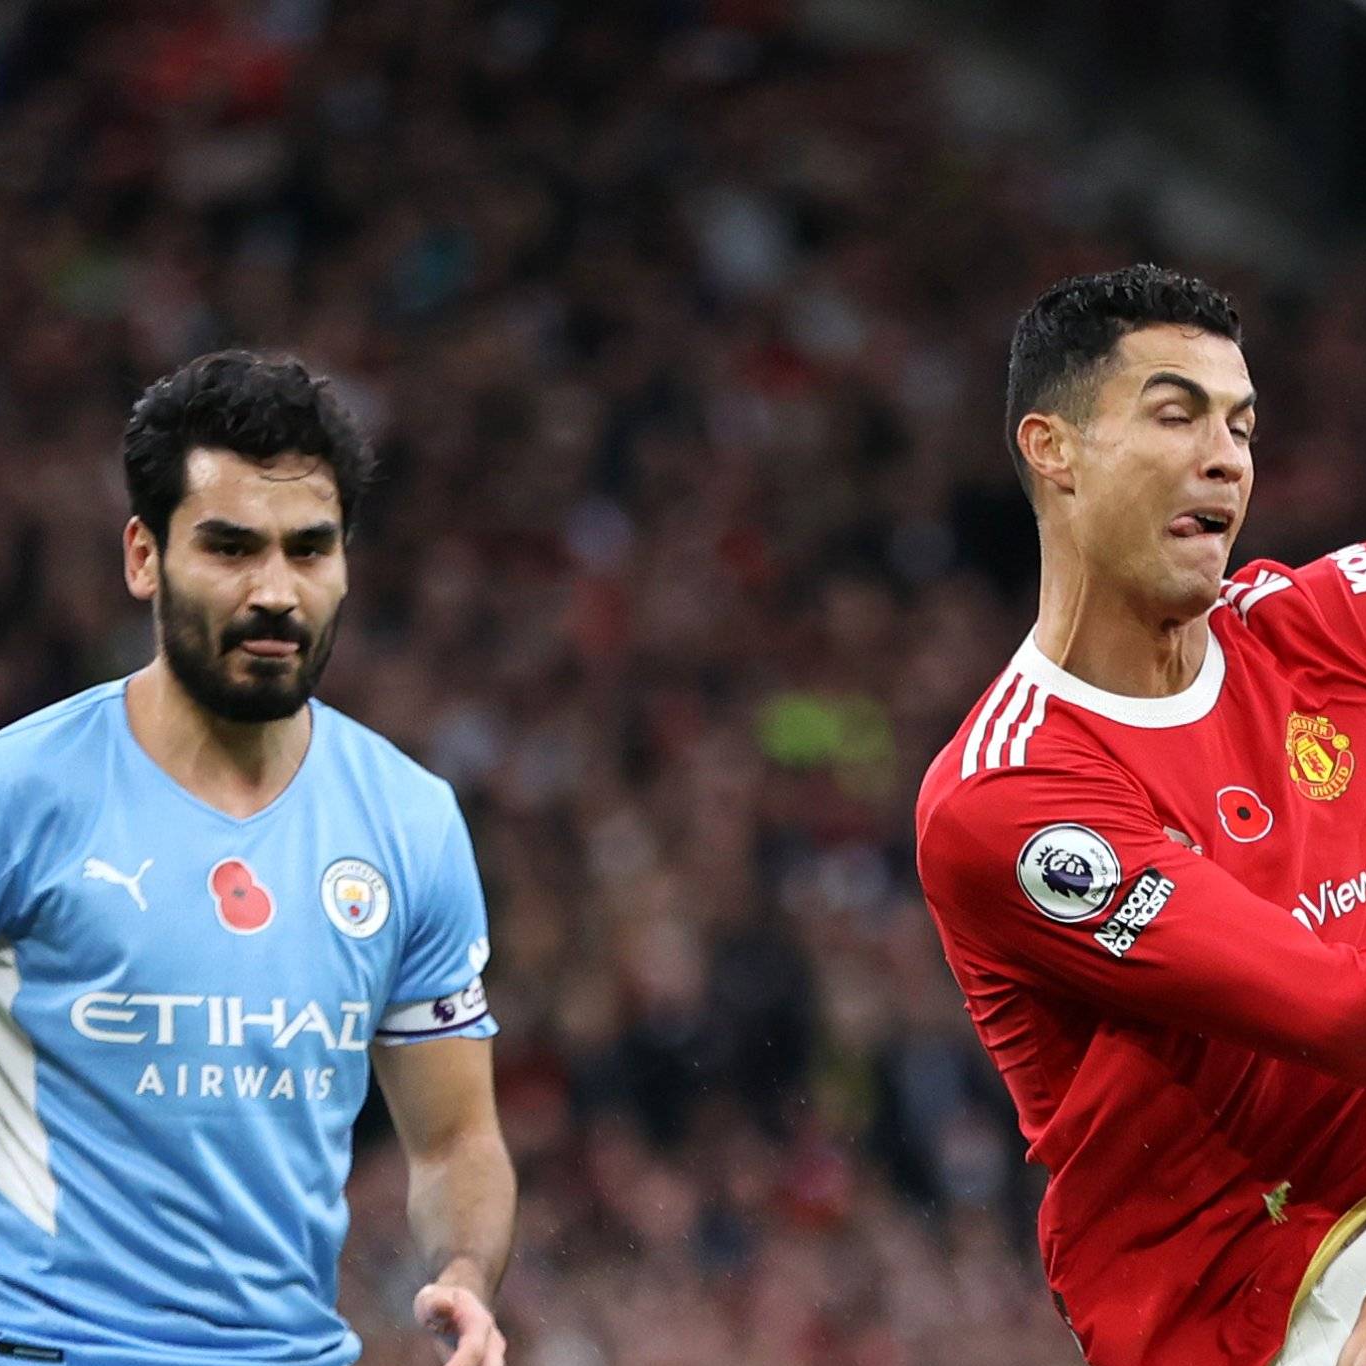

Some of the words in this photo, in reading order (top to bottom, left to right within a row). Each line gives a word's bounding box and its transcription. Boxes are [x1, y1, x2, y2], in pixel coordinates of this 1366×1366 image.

[1310, 766, 1350, 797] UNITED
[1093, 921, 1122, 950] No
[1114, 874, 1157, 924] room
[1108, 928, 1136, 958] for
[1127, 877, 1176, 932] racism
[135, 1063, 335, 1101] AIRWAYS
